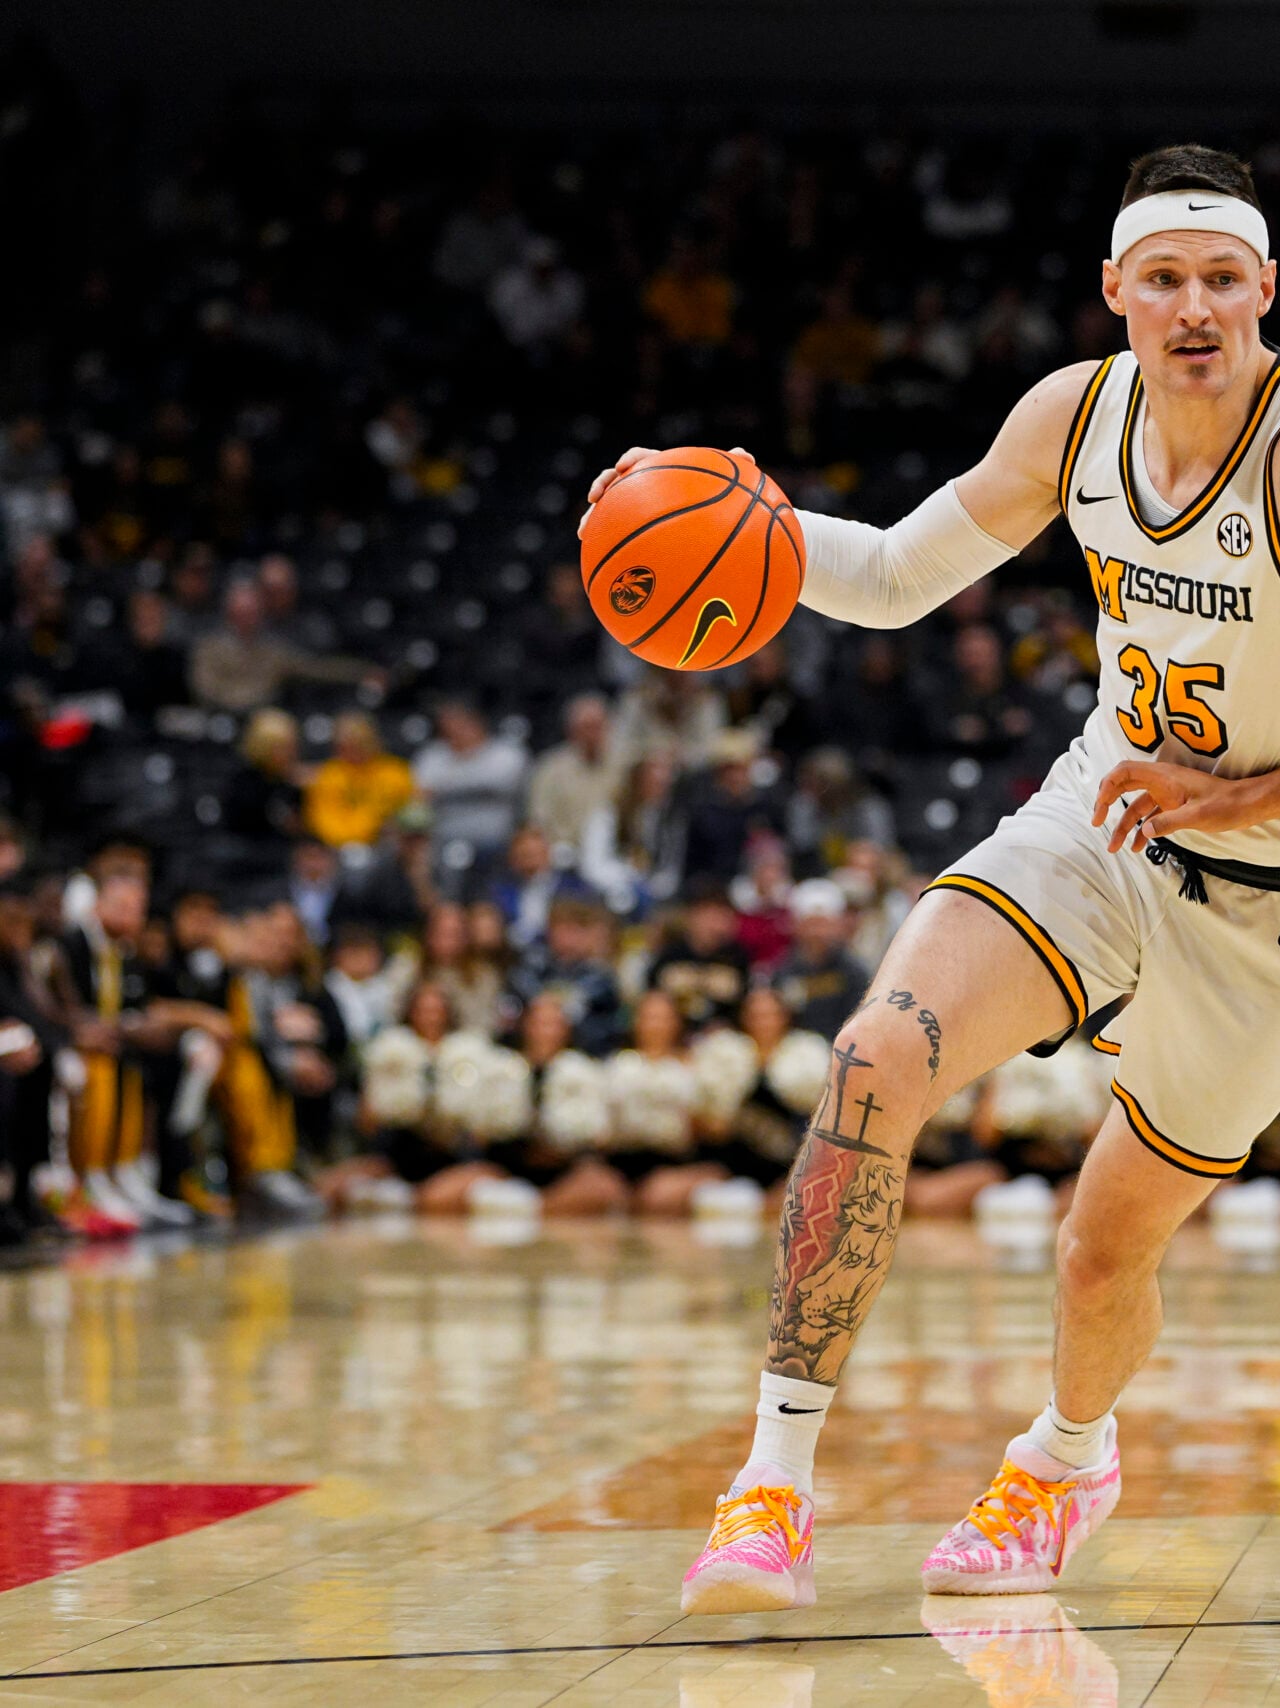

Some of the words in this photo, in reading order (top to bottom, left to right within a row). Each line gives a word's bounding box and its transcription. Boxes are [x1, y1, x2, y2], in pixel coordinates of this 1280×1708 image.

[1218, 514, 1251, 556] SEC
[1085, 545, 1254, 623] MISSOURI
[1116, 643, 1229, 758] 35
